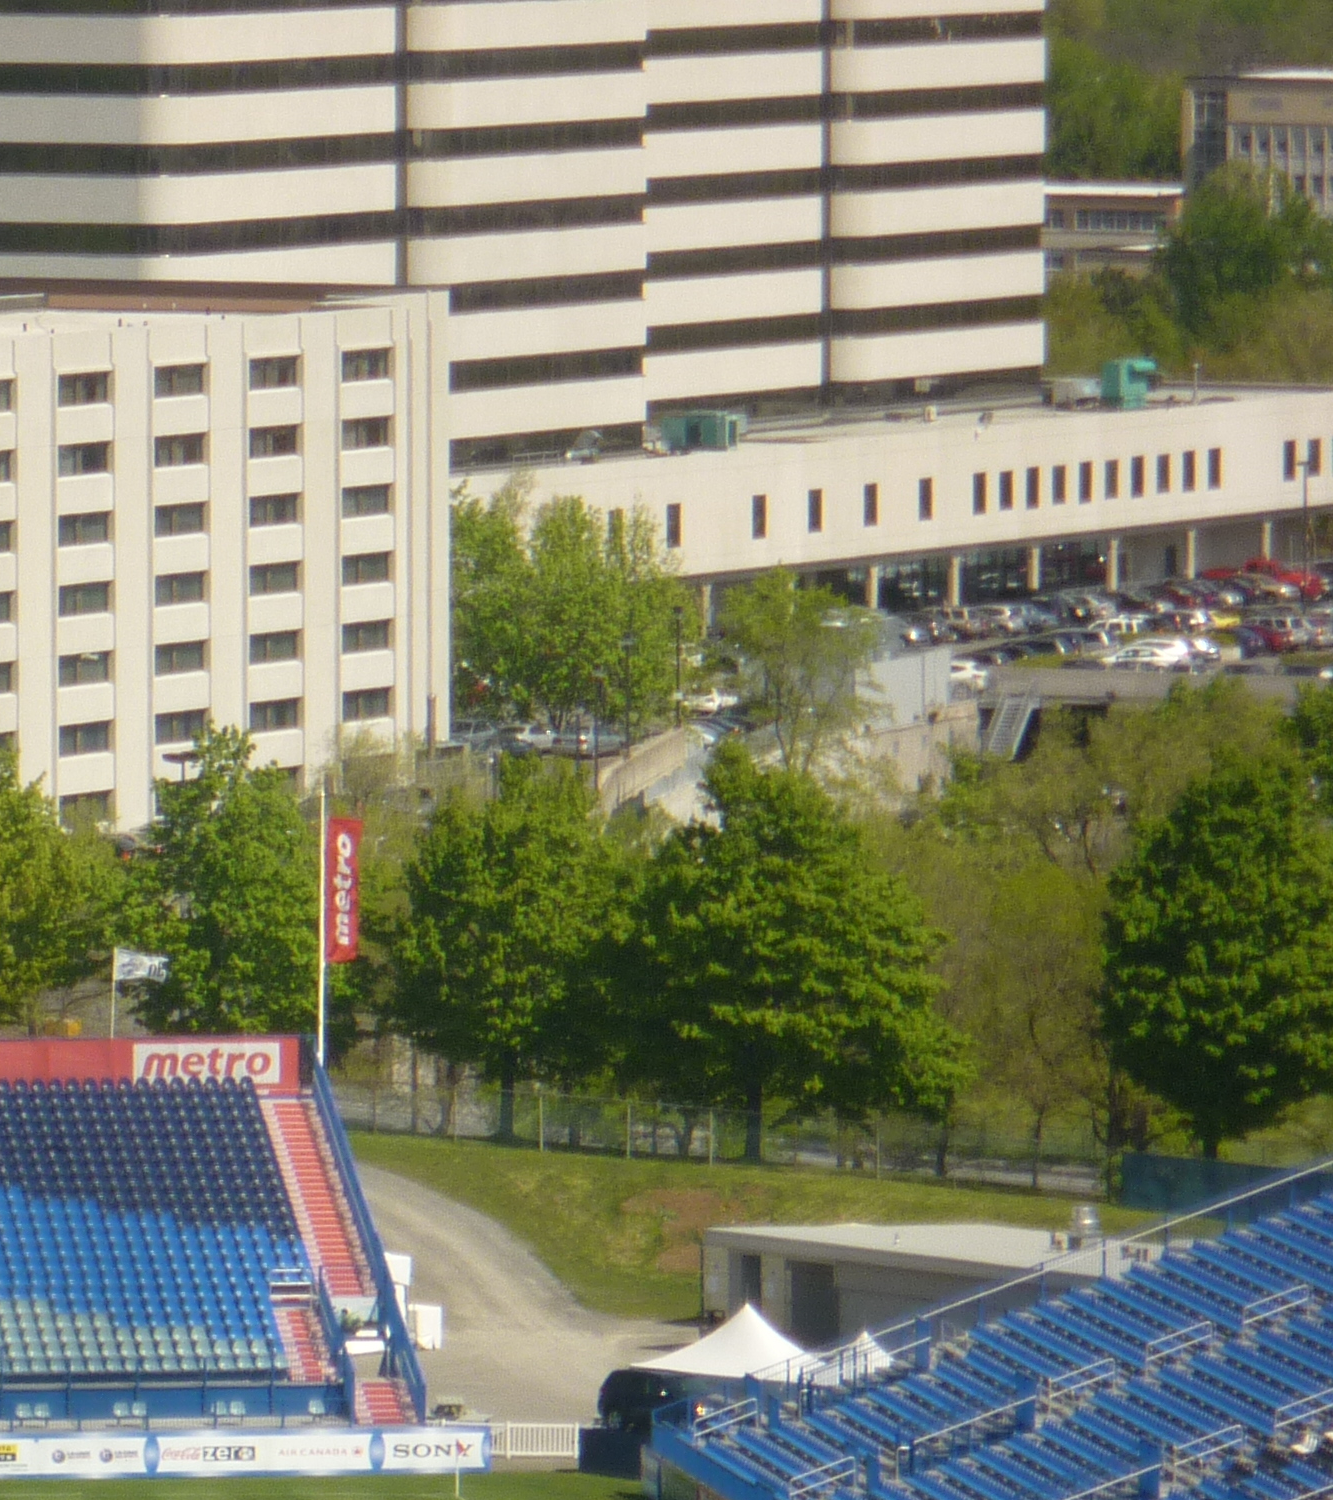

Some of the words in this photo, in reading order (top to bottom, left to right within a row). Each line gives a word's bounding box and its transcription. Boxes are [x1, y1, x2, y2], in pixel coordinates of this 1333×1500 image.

[334, 833, 352, 945] metro
[141, 1047, 273, 1078] metro
[203, 1446, 256, 1461] zero
[278, 1448, 298, 1456] AIR
[299, 1447, 347, 1456] CANADA
[393, 1443, 475, 1458] SONY
